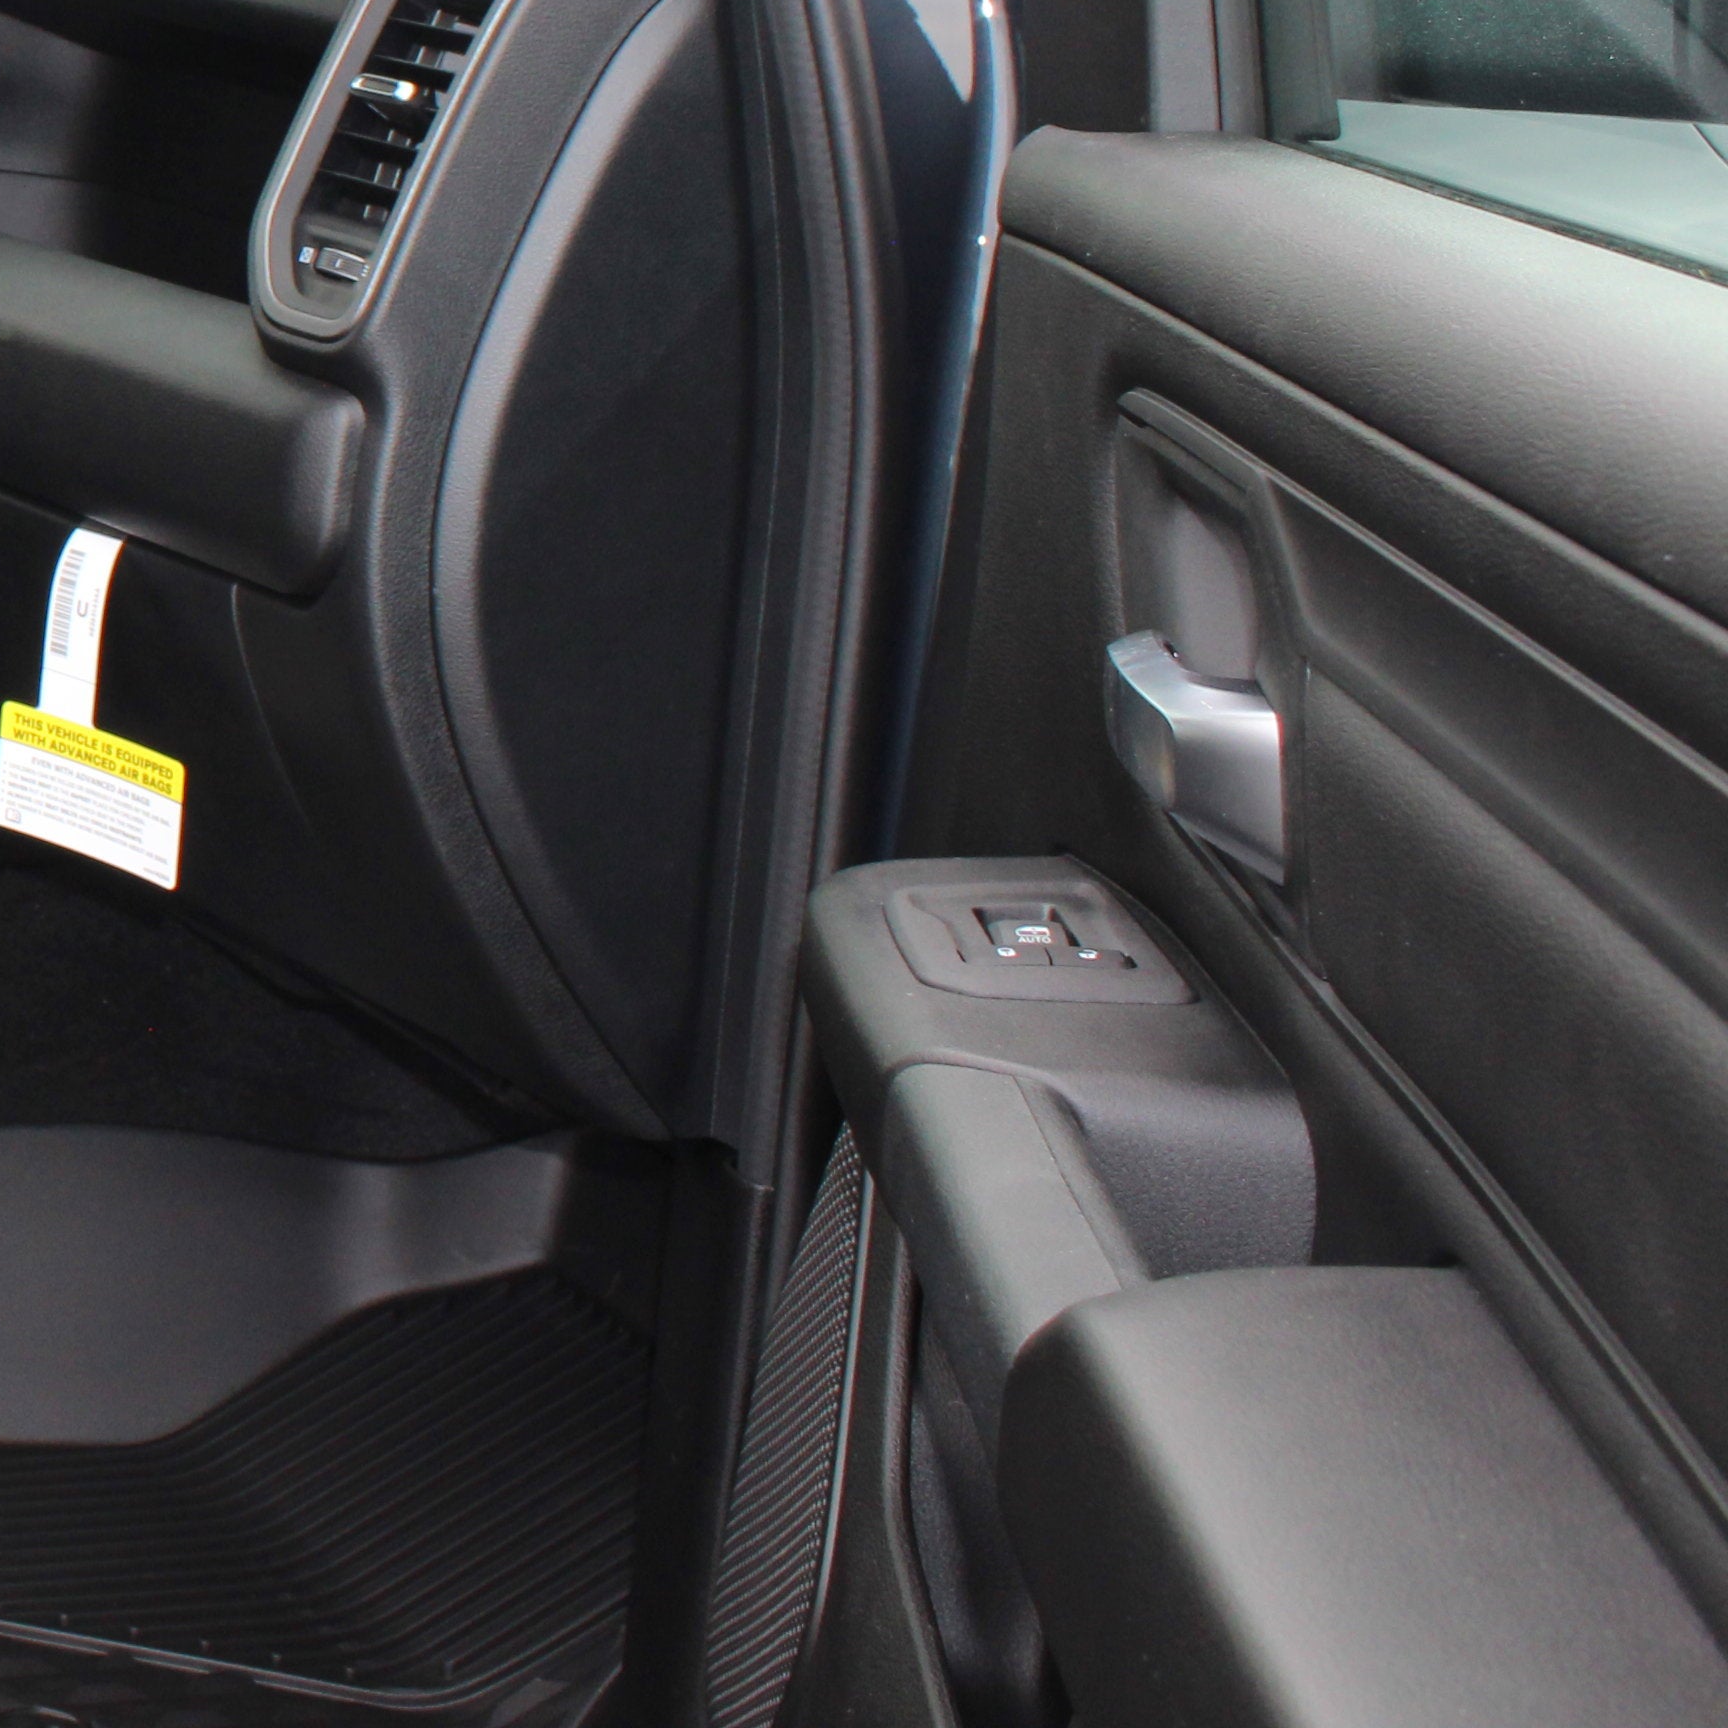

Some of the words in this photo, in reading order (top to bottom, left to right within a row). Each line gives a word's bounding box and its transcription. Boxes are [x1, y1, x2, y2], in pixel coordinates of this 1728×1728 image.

[13, 727, 46, 747] WITH
[49, 737, 117, 771] ADVANCED
[119, 765, 139, 782] AIR
[142, 772, 173, 795] BAGS
[14, 712, 44, 732] THIS
[46, 721, 99, 751] VEHICLE
[101, 742, 113, 756] IS
[116, 748, 174, 780] EQUIPPED
[31, 756, 53, 770] EVEN
[54, 762, 74, 777] WITH
[75, 769, 117, 793] ADVANCED
[117, 785, 130, 798] AIR
[131, 790, 151, 807] BAGS
[1018, 936, 1051, 944] AUTO
